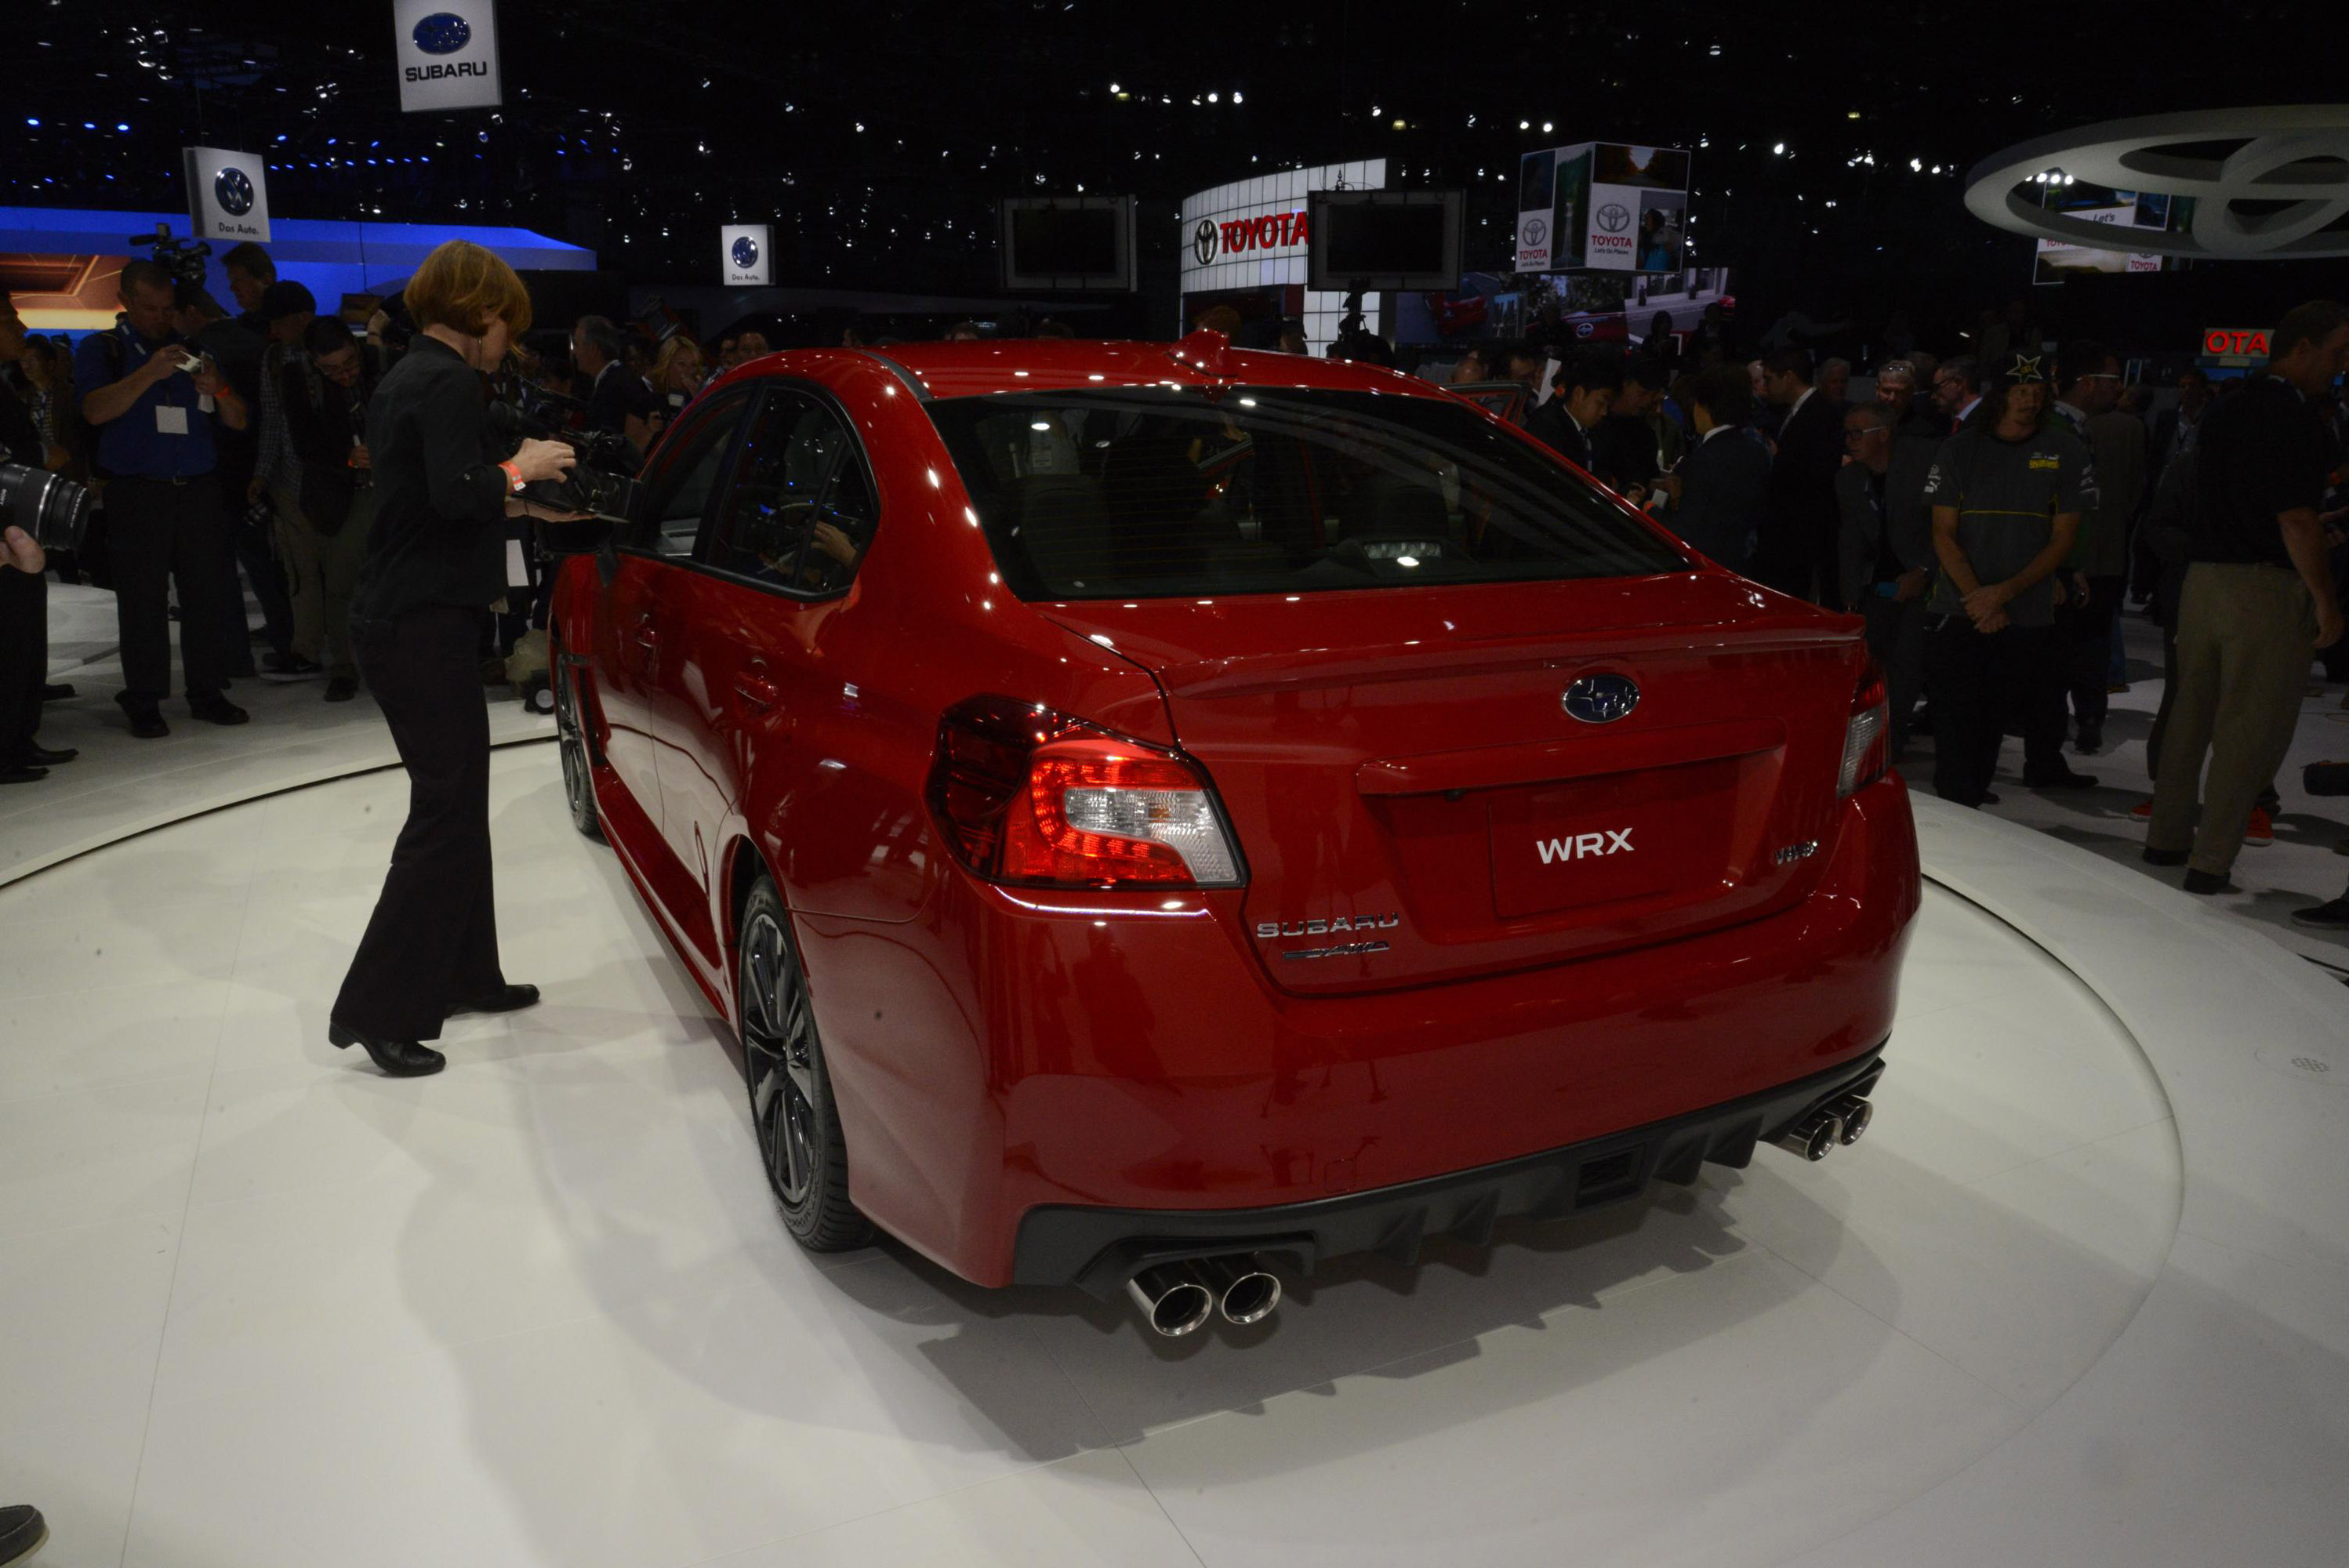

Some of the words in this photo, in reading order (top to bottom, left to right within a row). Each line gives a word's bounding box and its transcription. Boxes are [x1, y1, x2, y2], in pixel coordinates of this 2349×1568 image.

[405, 62, 487, 82] SUBARU
[219, 222, 235, 233] Das
[1220, 212, 1310, 254] TOYOTA
[1592, 235, 1632, 248] TOYOTA
[1519, 249, 1548, 260] TOYOTA
[2131, 260, 2158, 271] TOYOTA
[2206, 331, 2268, 354] OTA
[1536, 827, 1636, 865] WRX
[1257, 912, 1400, 938] SUBARU
